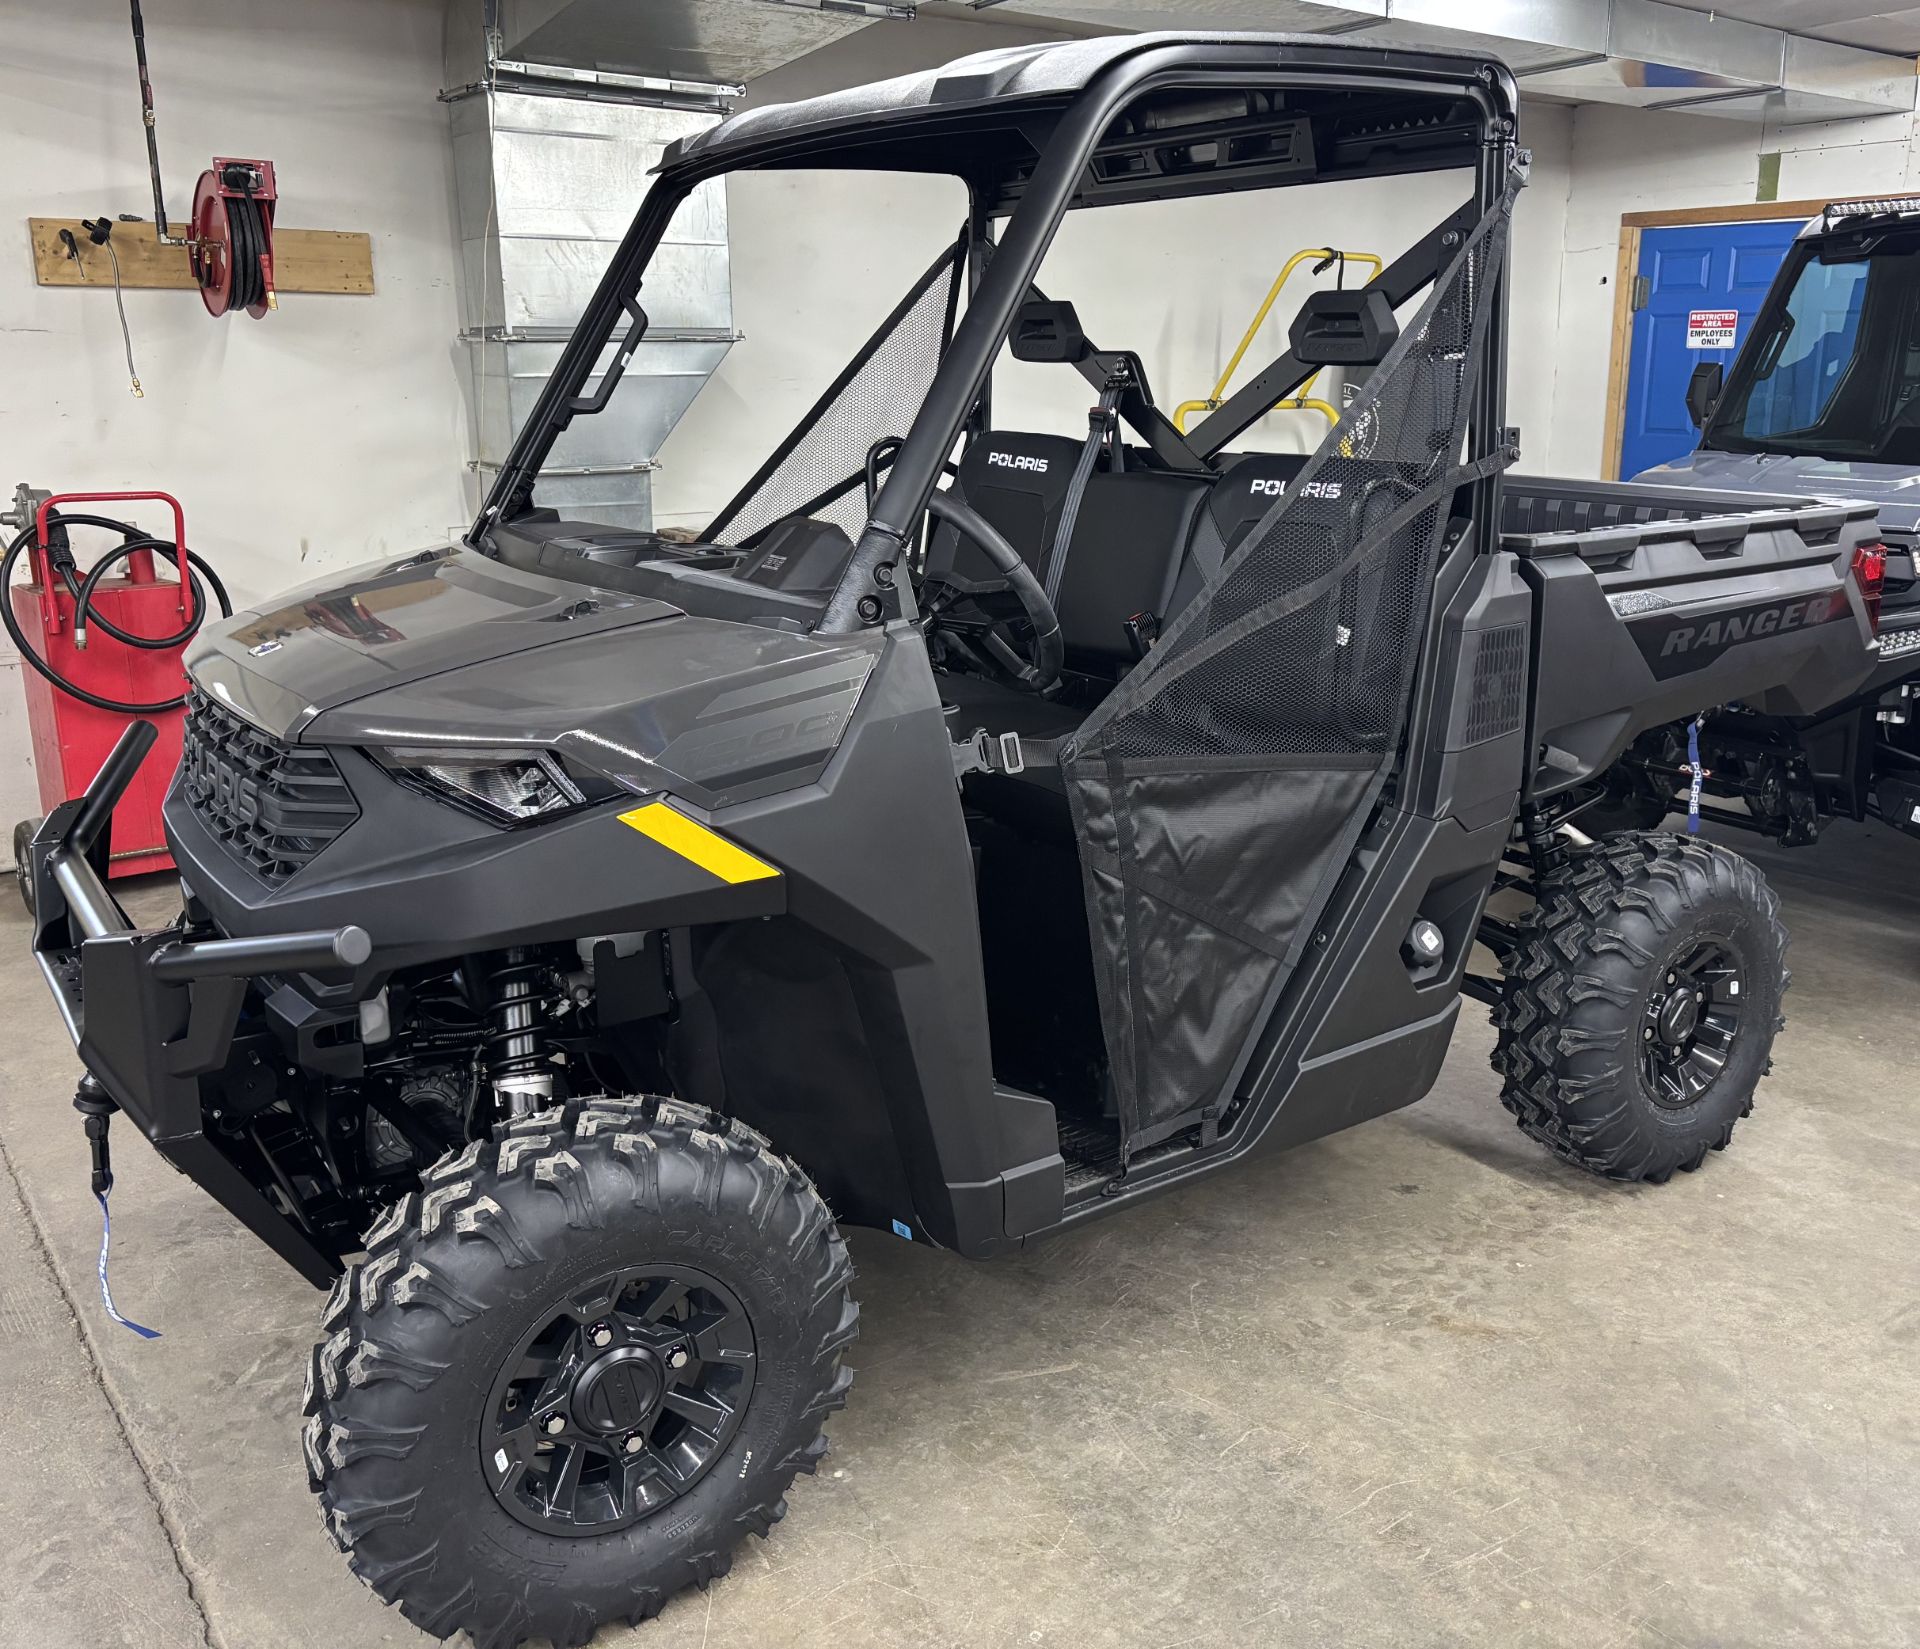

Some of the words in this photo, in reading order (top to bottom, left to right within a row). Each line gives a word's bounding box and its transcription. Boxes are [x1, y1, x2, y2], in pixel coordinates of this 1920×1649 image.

[1692, 313, 1735, 321] RESTRICTED
[1701, 338, 1720, 346] ONLY
[988, 452, 1049, 473] POLARIS
[1250, 480, 1342, 498] POLRIS
[1660, 597, 1831, 656] RANGER
[1689, 761, 1702, 815] POLARIS
